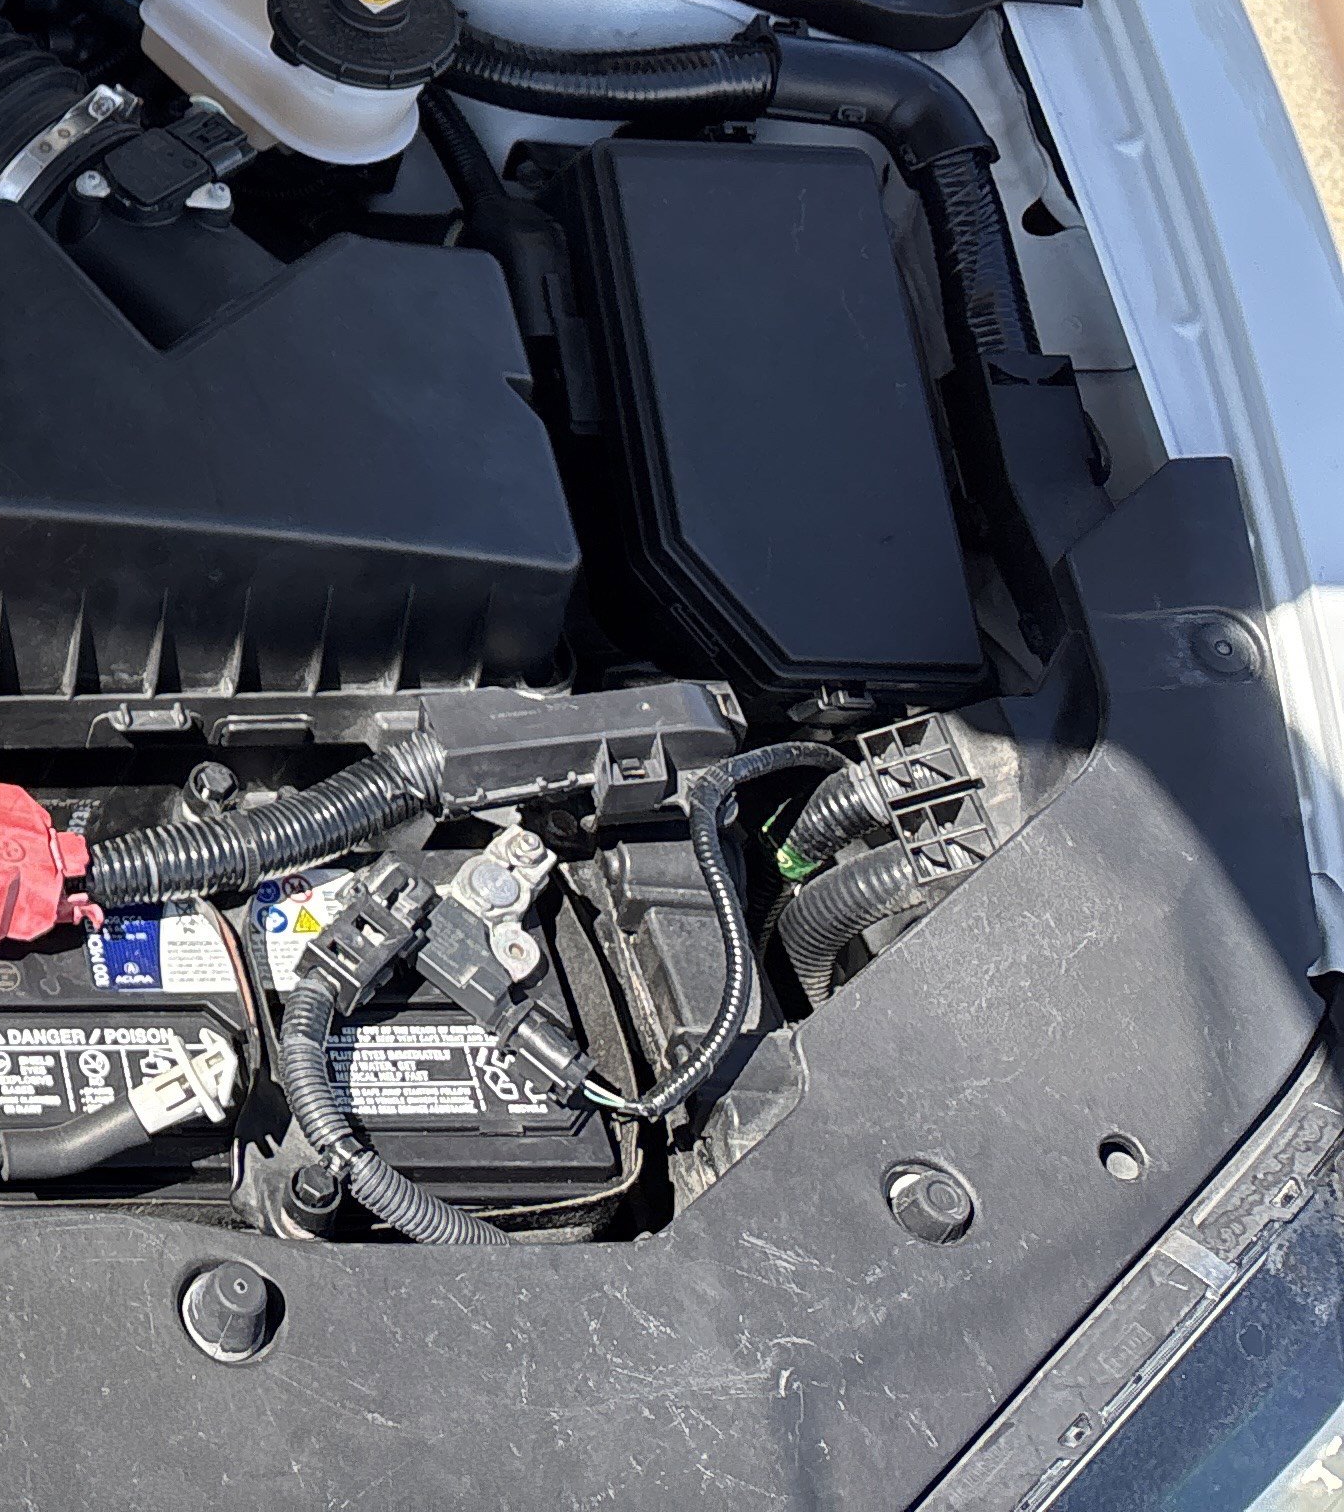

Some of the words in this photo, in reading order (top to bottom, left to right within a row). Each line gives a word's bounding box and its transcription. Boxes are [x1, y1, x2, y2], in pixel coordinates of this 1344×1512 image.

[115, 974, 155, 985] ACURA
[6, 1028, 87, 1045] DANGER
[104, 1028, 176, 1045] POISON
